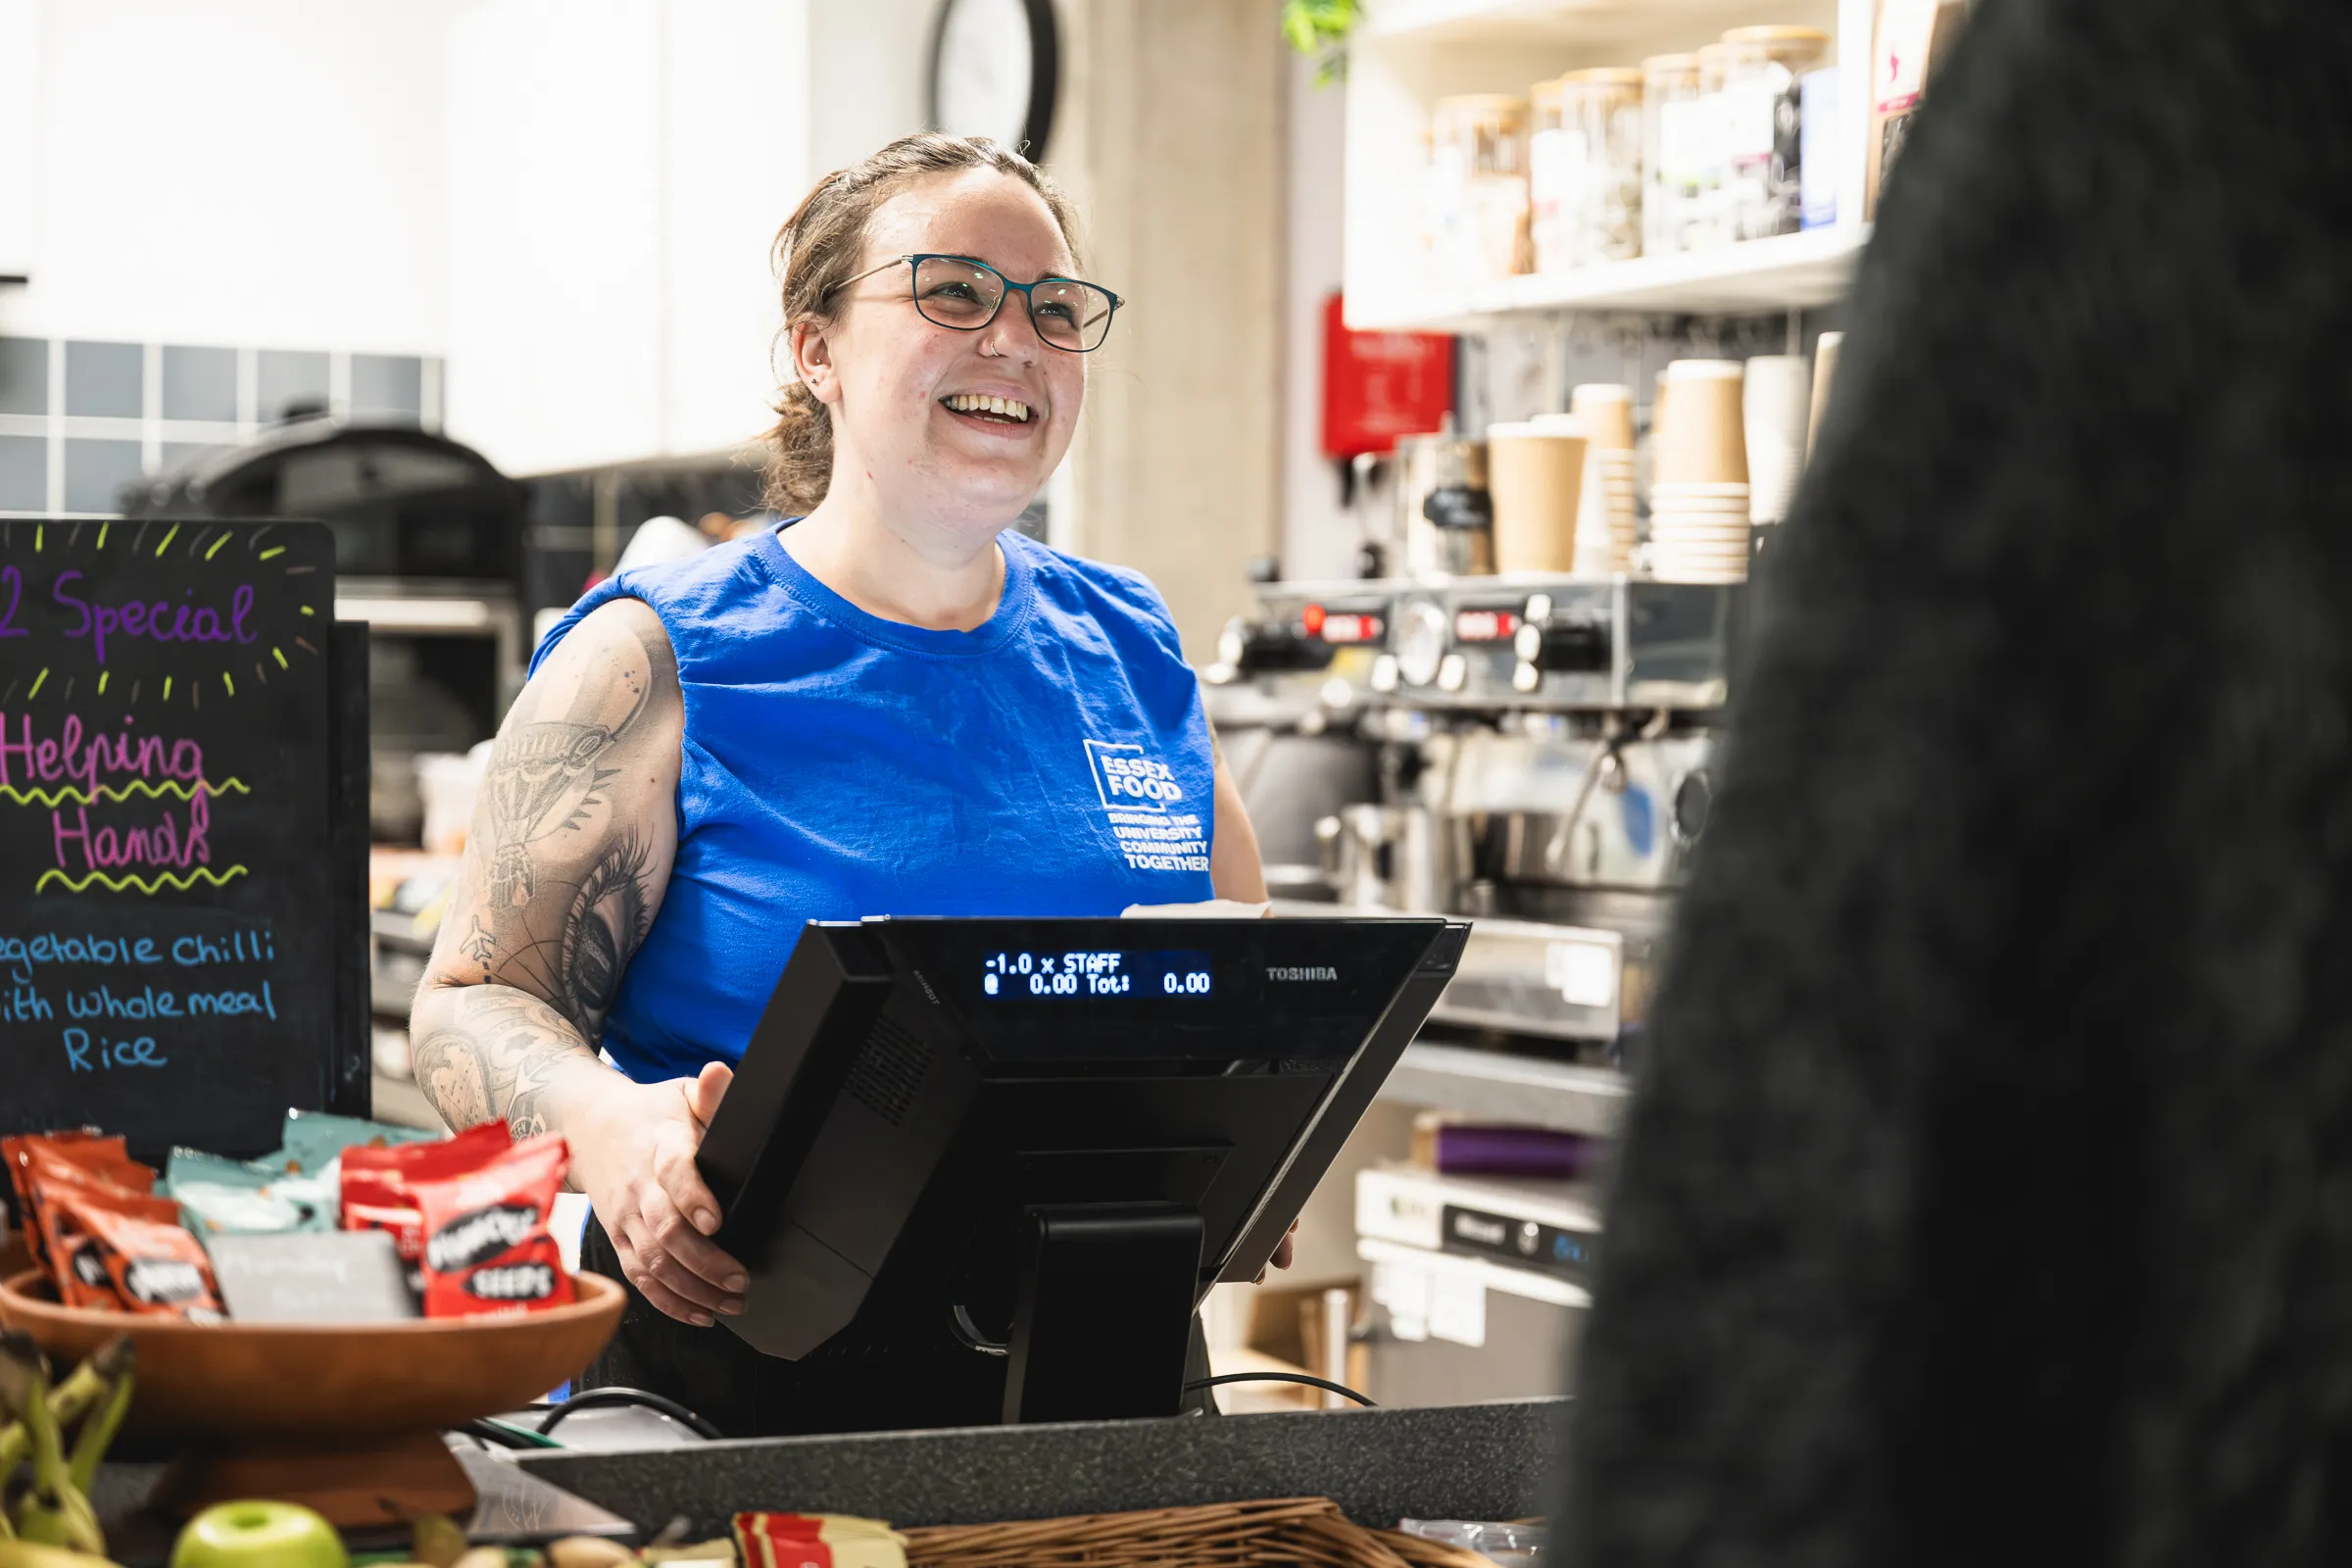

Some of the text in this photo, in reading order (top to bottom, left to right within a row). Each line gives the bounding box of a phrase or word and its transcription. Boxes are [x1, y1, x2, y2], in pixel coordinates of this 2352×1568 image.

[0, 565, 258, 663] 2 Special
[0, 710, 209, 829] Helping
[1100, 755, 1176, 781] ESSEX
[1106, 774, 1183, 801] FOOD
[1107, 812, 1200, 826] BRINGING THE
[53, 806, 211, 869] Hands
[1112, 826, 1203, 841] UNIVERSITY
[1119, 841, 1208, 855] COMMUNITY
[1124, 854, 1210, 872] TOGETHER
[986, 953, 1122, 974] -1.0 x STAFF
[1265, 966, 1338, 981] TOSHIBA
[1029, 973, 1078, 995] 0.00
[1086, 973, 1130, 994] Tot:
[1163, 972, 1211, 994] 0.00
[0, 985, 53, 1022] ith
[64, 1027, 169, 1074] Rice
